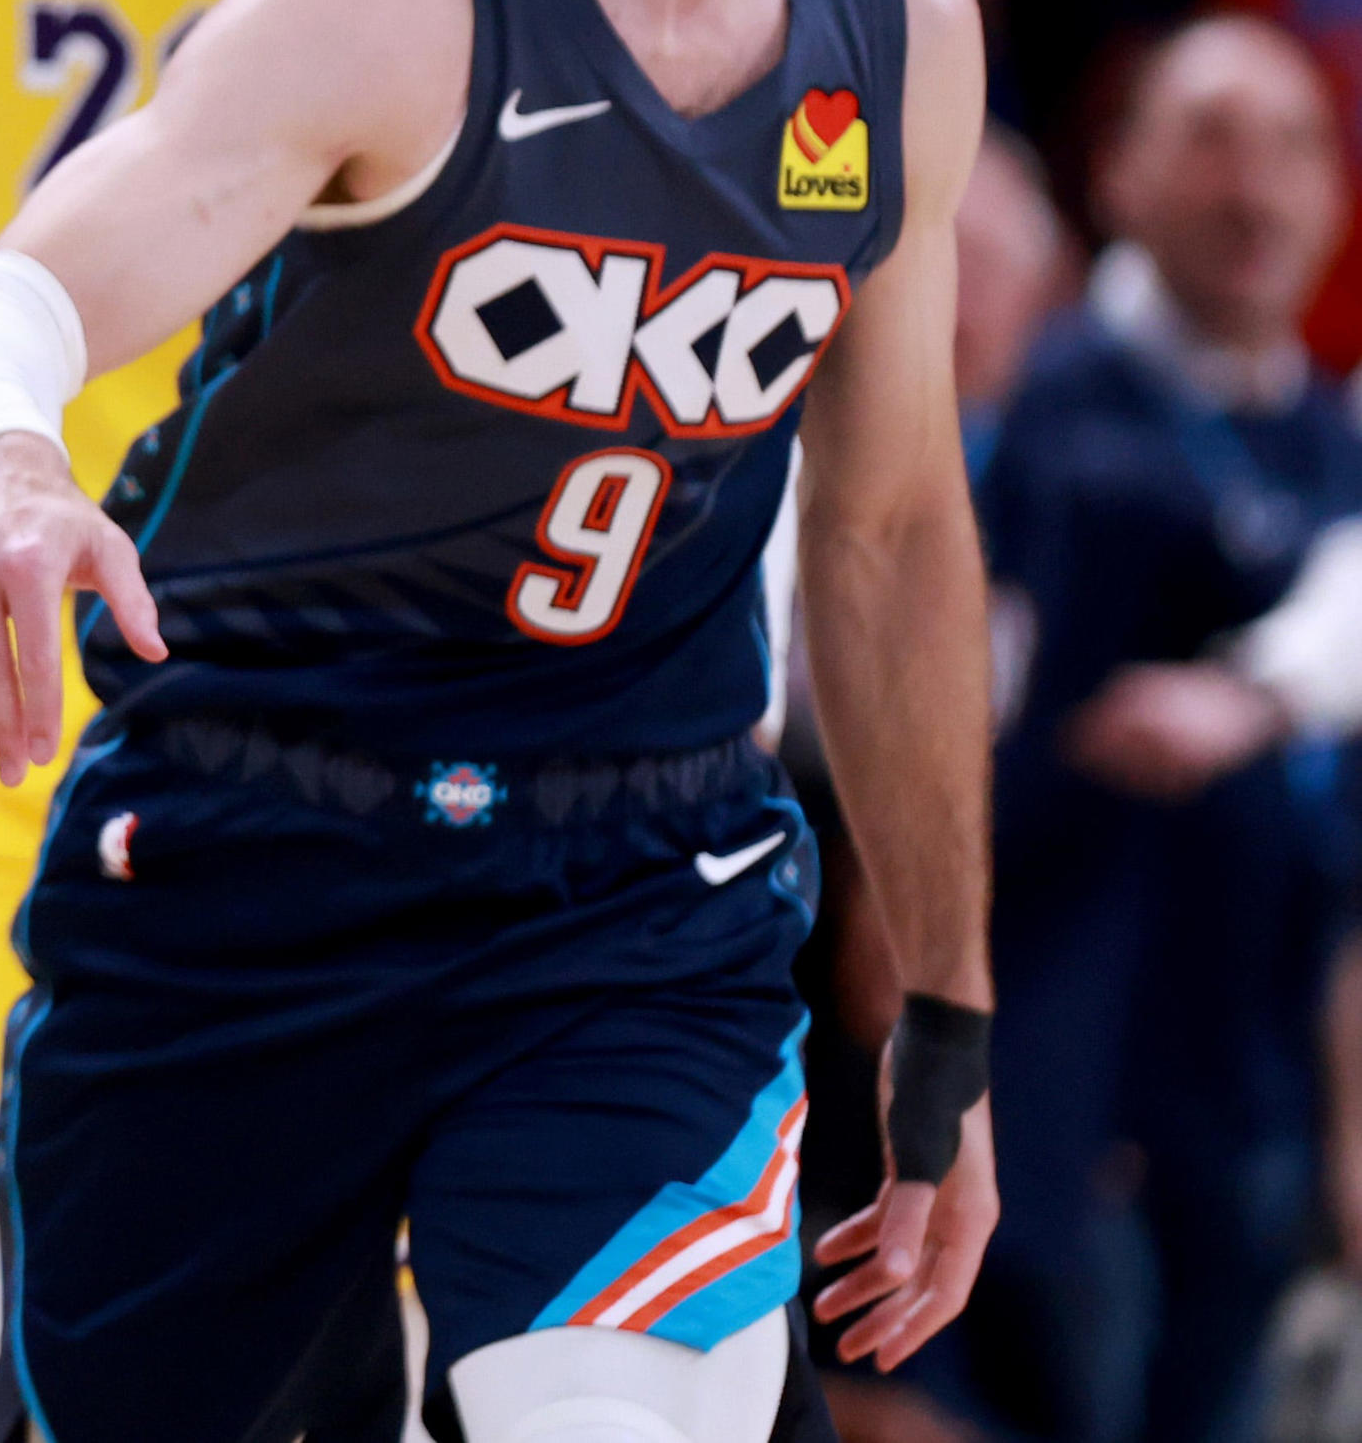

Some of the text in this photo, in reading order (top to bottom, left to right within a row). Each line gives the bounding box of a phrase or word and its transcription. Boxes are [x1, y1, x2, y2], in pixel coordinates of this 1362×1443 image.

[25, 1, 201, 193] 2
[417, 225, 850, 436] OKC
[508, 449, 671, 644] 9
